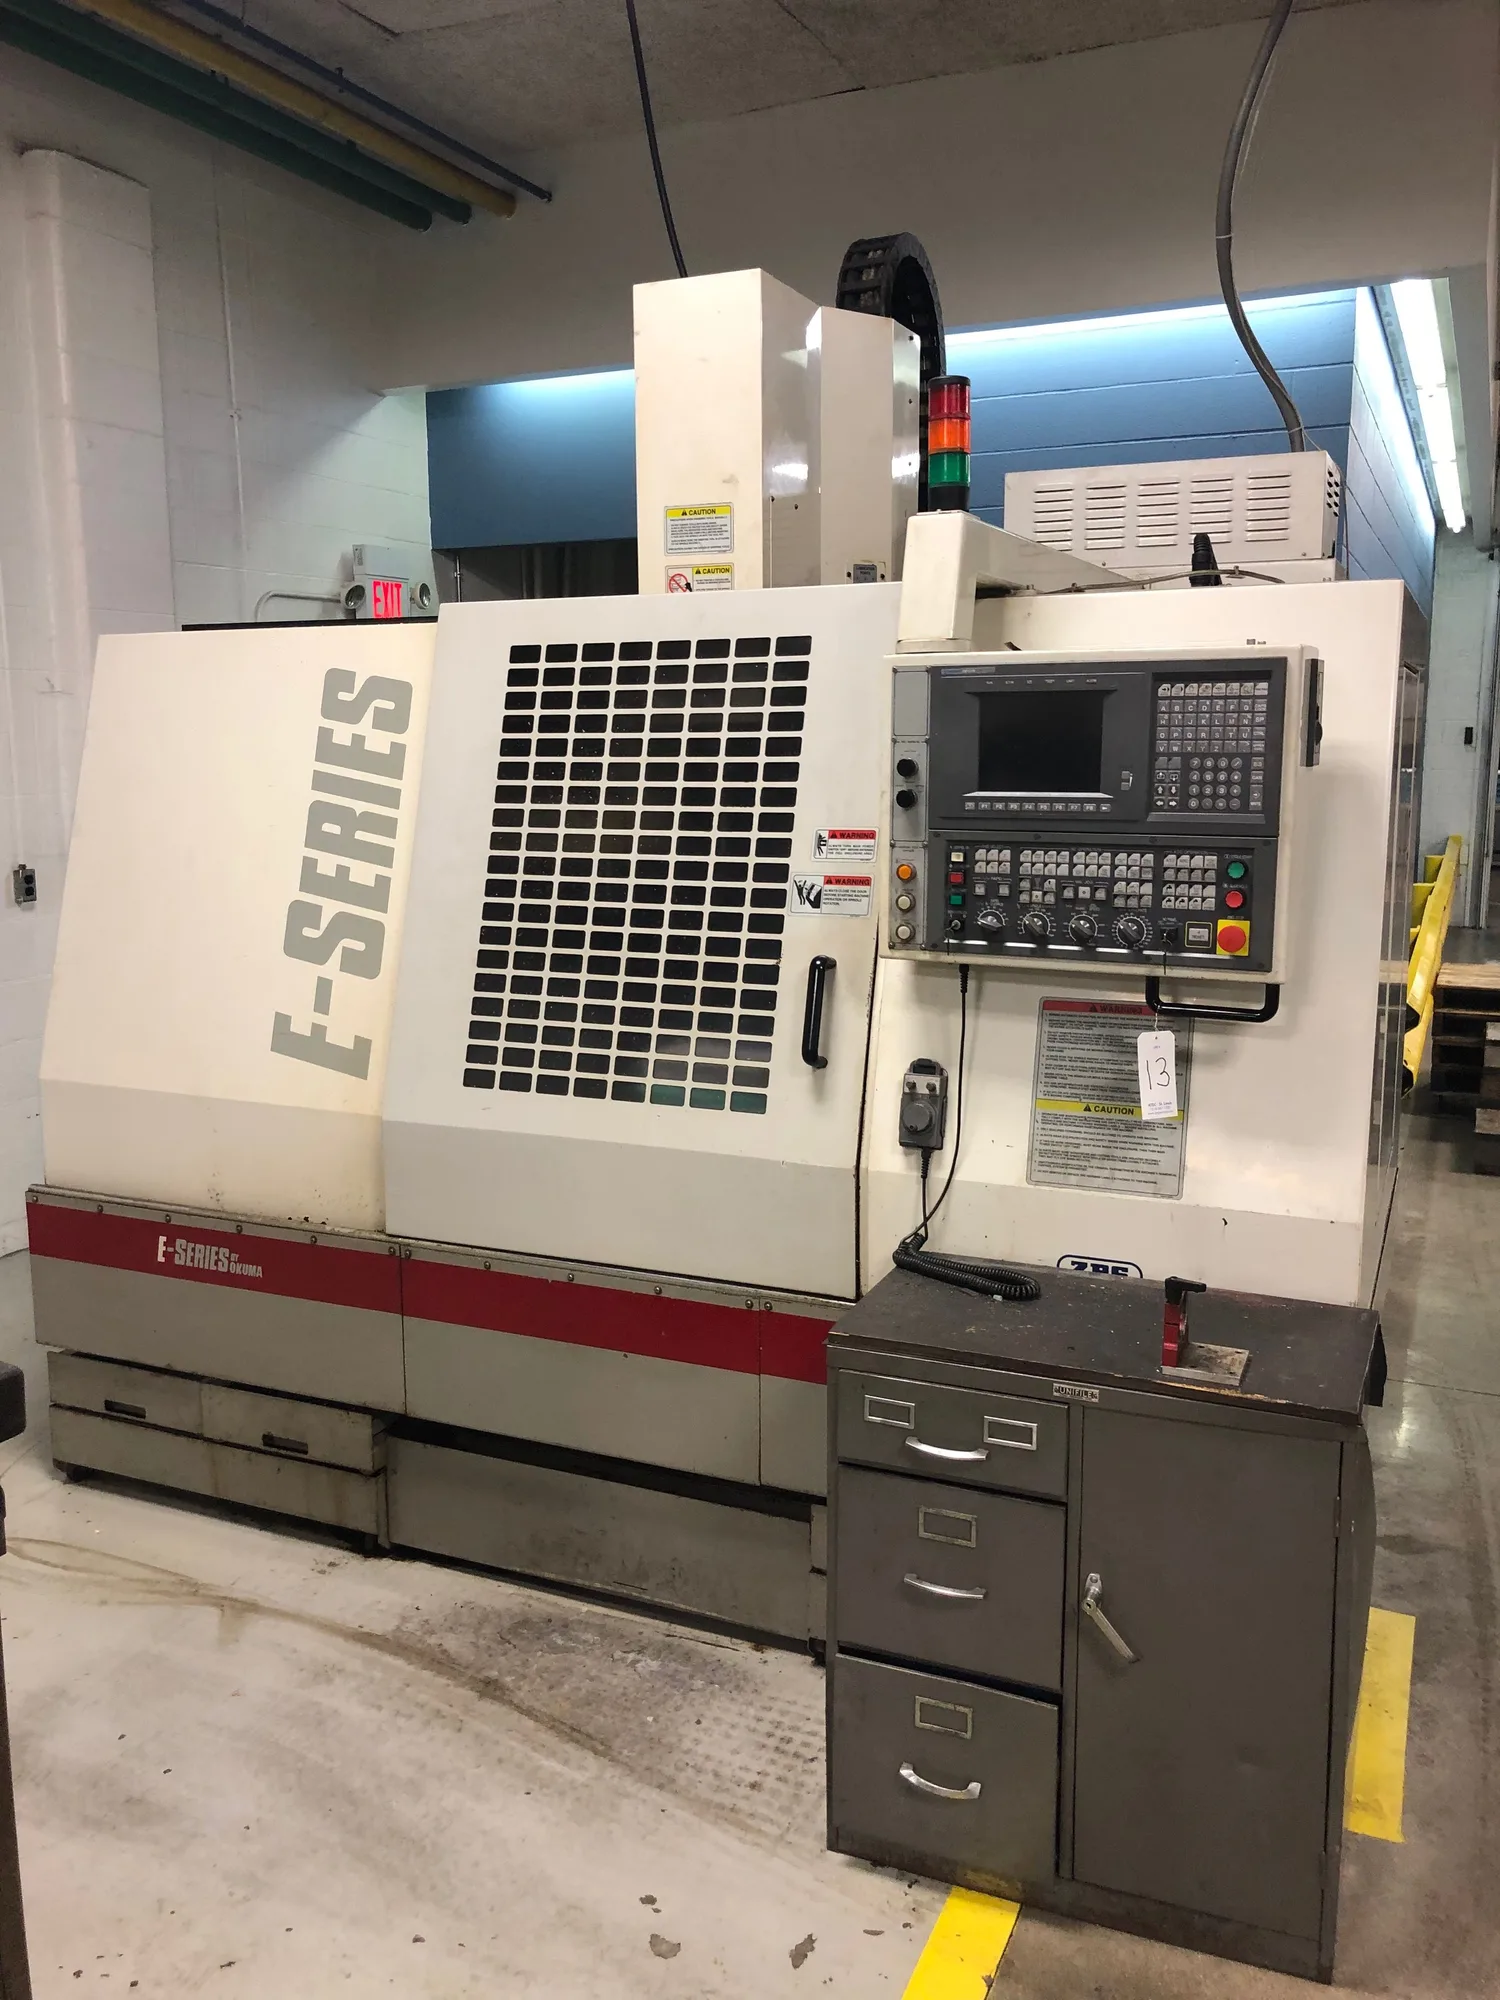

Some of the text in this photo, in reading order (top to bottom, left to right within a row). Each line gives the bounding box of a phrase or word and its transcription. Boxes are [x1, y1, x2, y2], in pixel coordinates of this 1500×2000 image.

[373, 580, 402, 618] EXIT
[270, 667, 413, 1080] E-SERIES
[1100, 1004, 1142, 1014] WARNING
[1146, 1057, 1170, 1090] 13
[1094, 1106, 1134, 1115] CAUTION
[158, 1235, 239, 1272] E-SERIES BY
[230, 1262, 262, 1278] OKUMA
